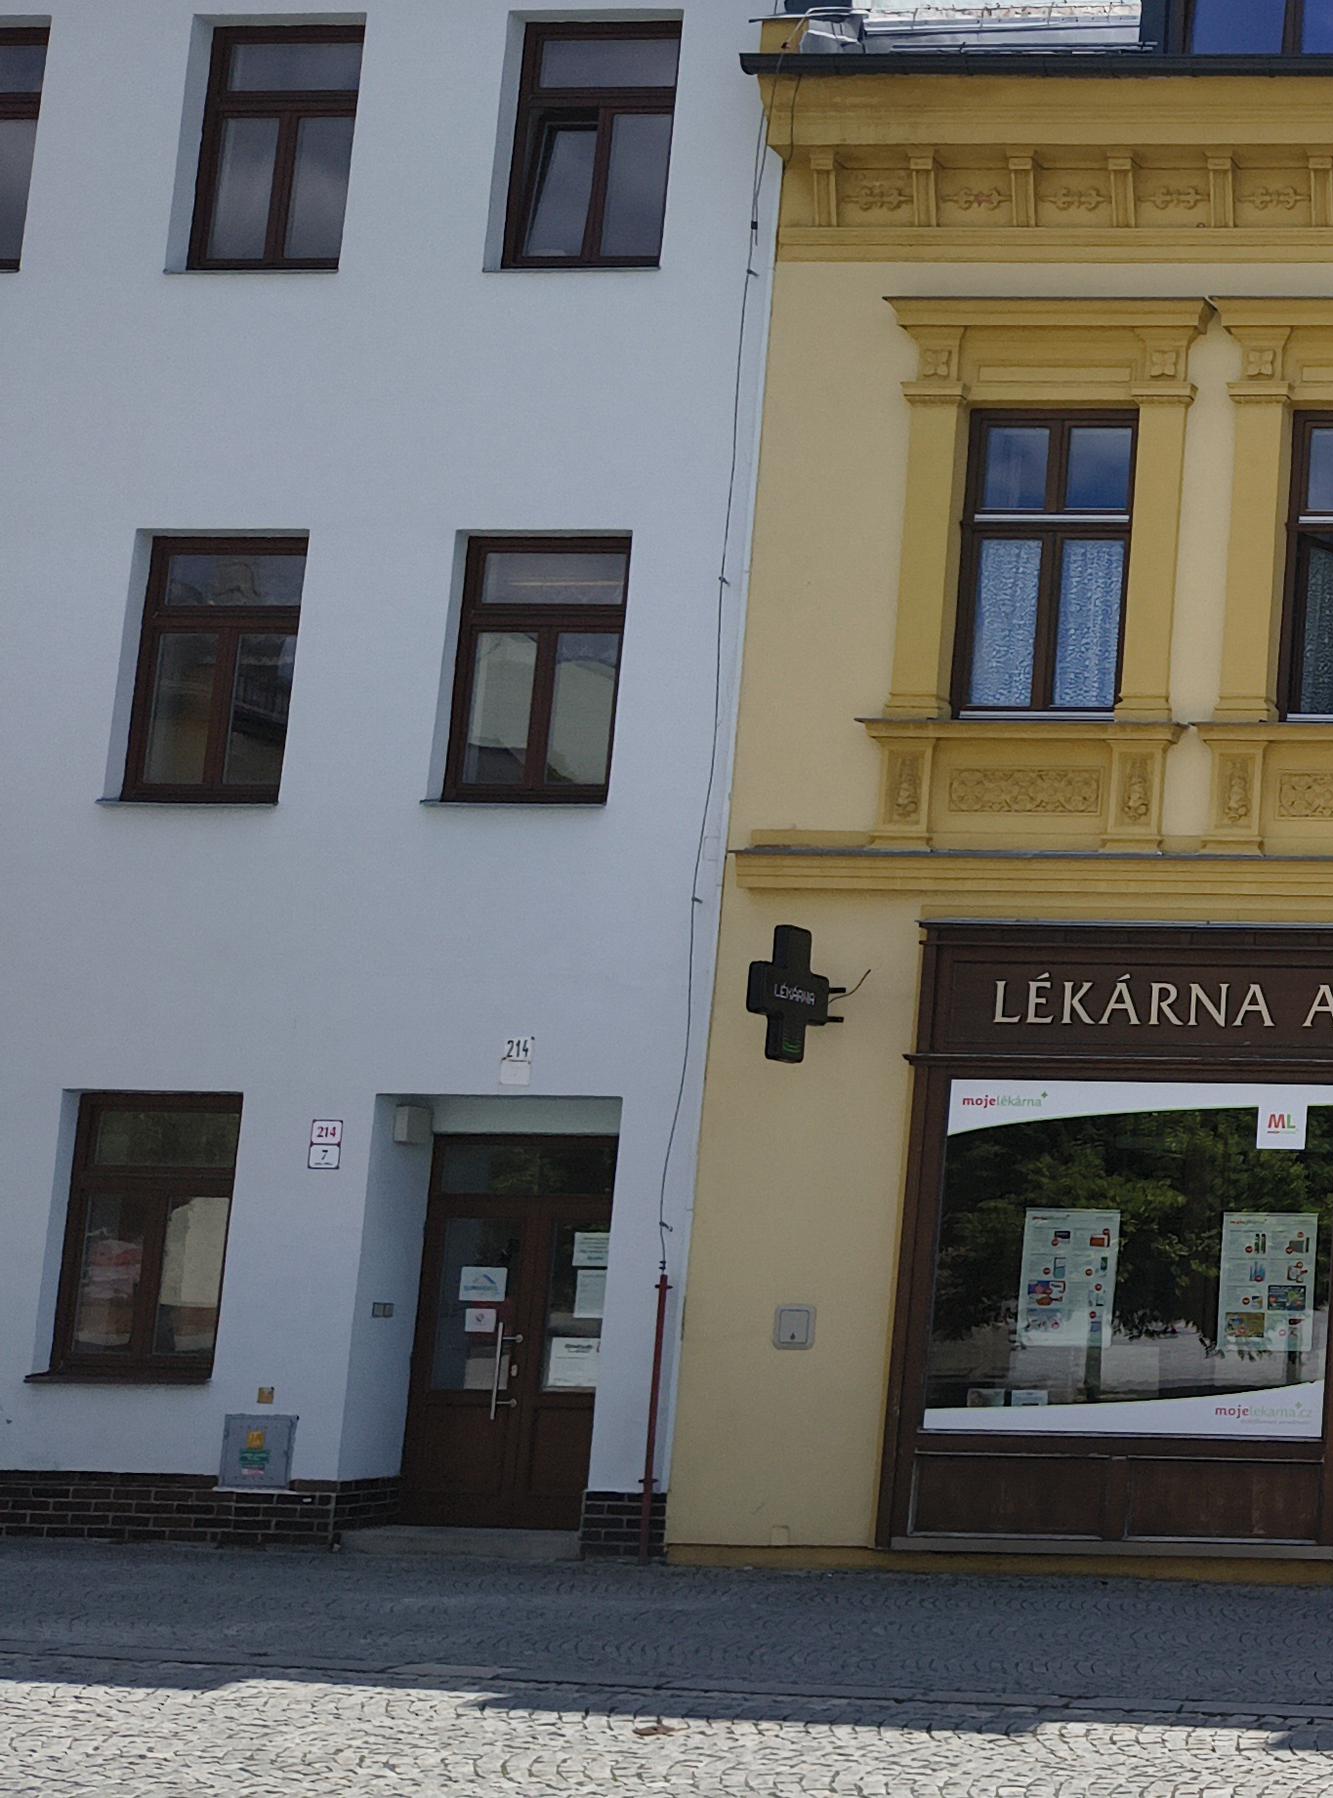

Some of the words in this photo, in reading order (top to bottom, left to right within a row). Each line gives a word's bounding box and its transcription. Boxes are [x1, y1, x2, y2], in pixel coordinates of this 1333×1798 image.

[993, 972, 1274, 1027] LÉKÁRNA
[506, 1039, 529, 1058] 214
[1267, 1113, 1296, 1129] ML
[316, 1126, 337, 1138] 214
[321, 1149, 329, 1161] 7
